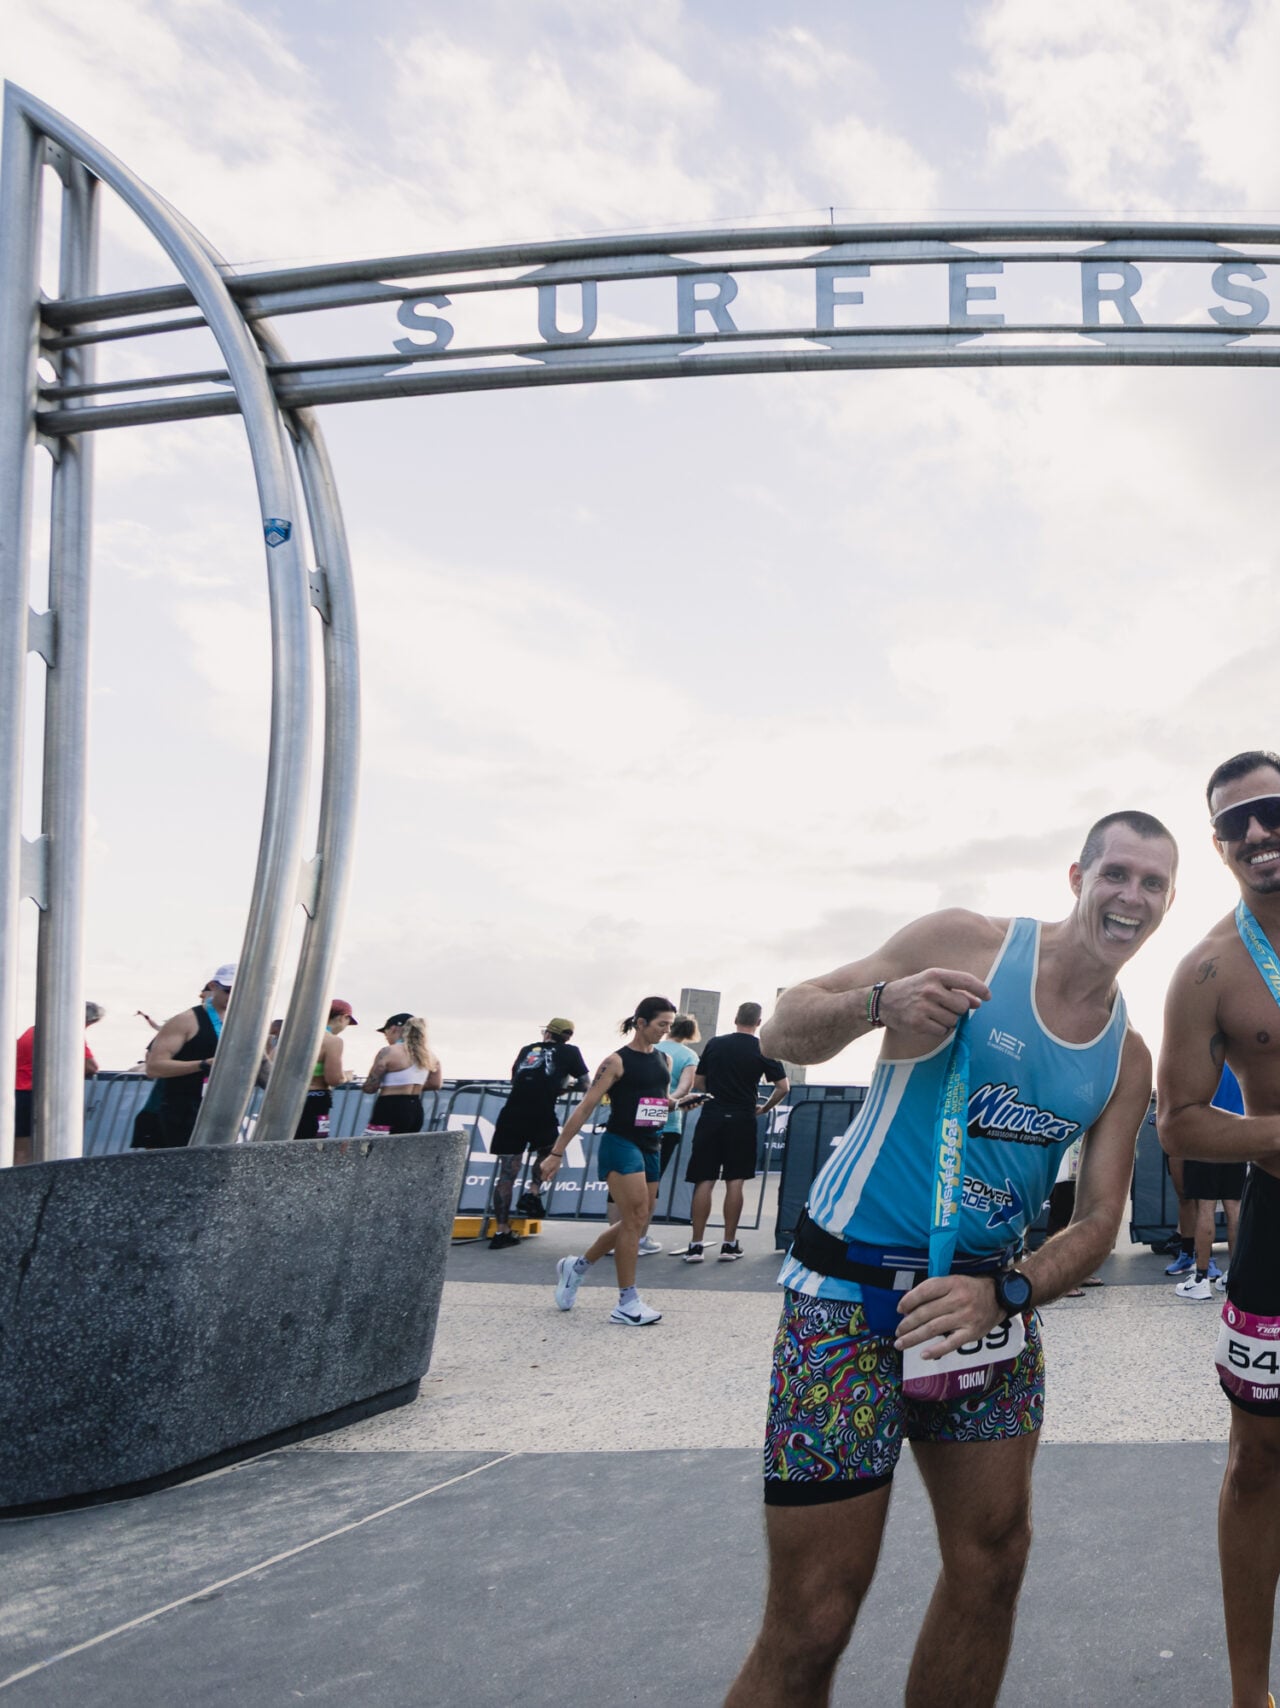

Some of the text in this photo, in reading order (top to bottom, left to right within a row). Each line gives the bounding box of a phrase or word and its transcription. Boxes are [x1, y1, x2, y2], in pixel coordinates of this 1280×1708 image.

[393, 261, 1270, 352] SURFERS
[988, 1028, 1026, 1055] NET
[967, 1084, 1080, 1141] Winners
[941, 1117, 958, 1227] FINISHER 2026
[963, 1175, 1014, 1207] POWER
[958, 1370, 985, 1390] 10KM
[1251, 1386, 1279, 1400] 10KM
